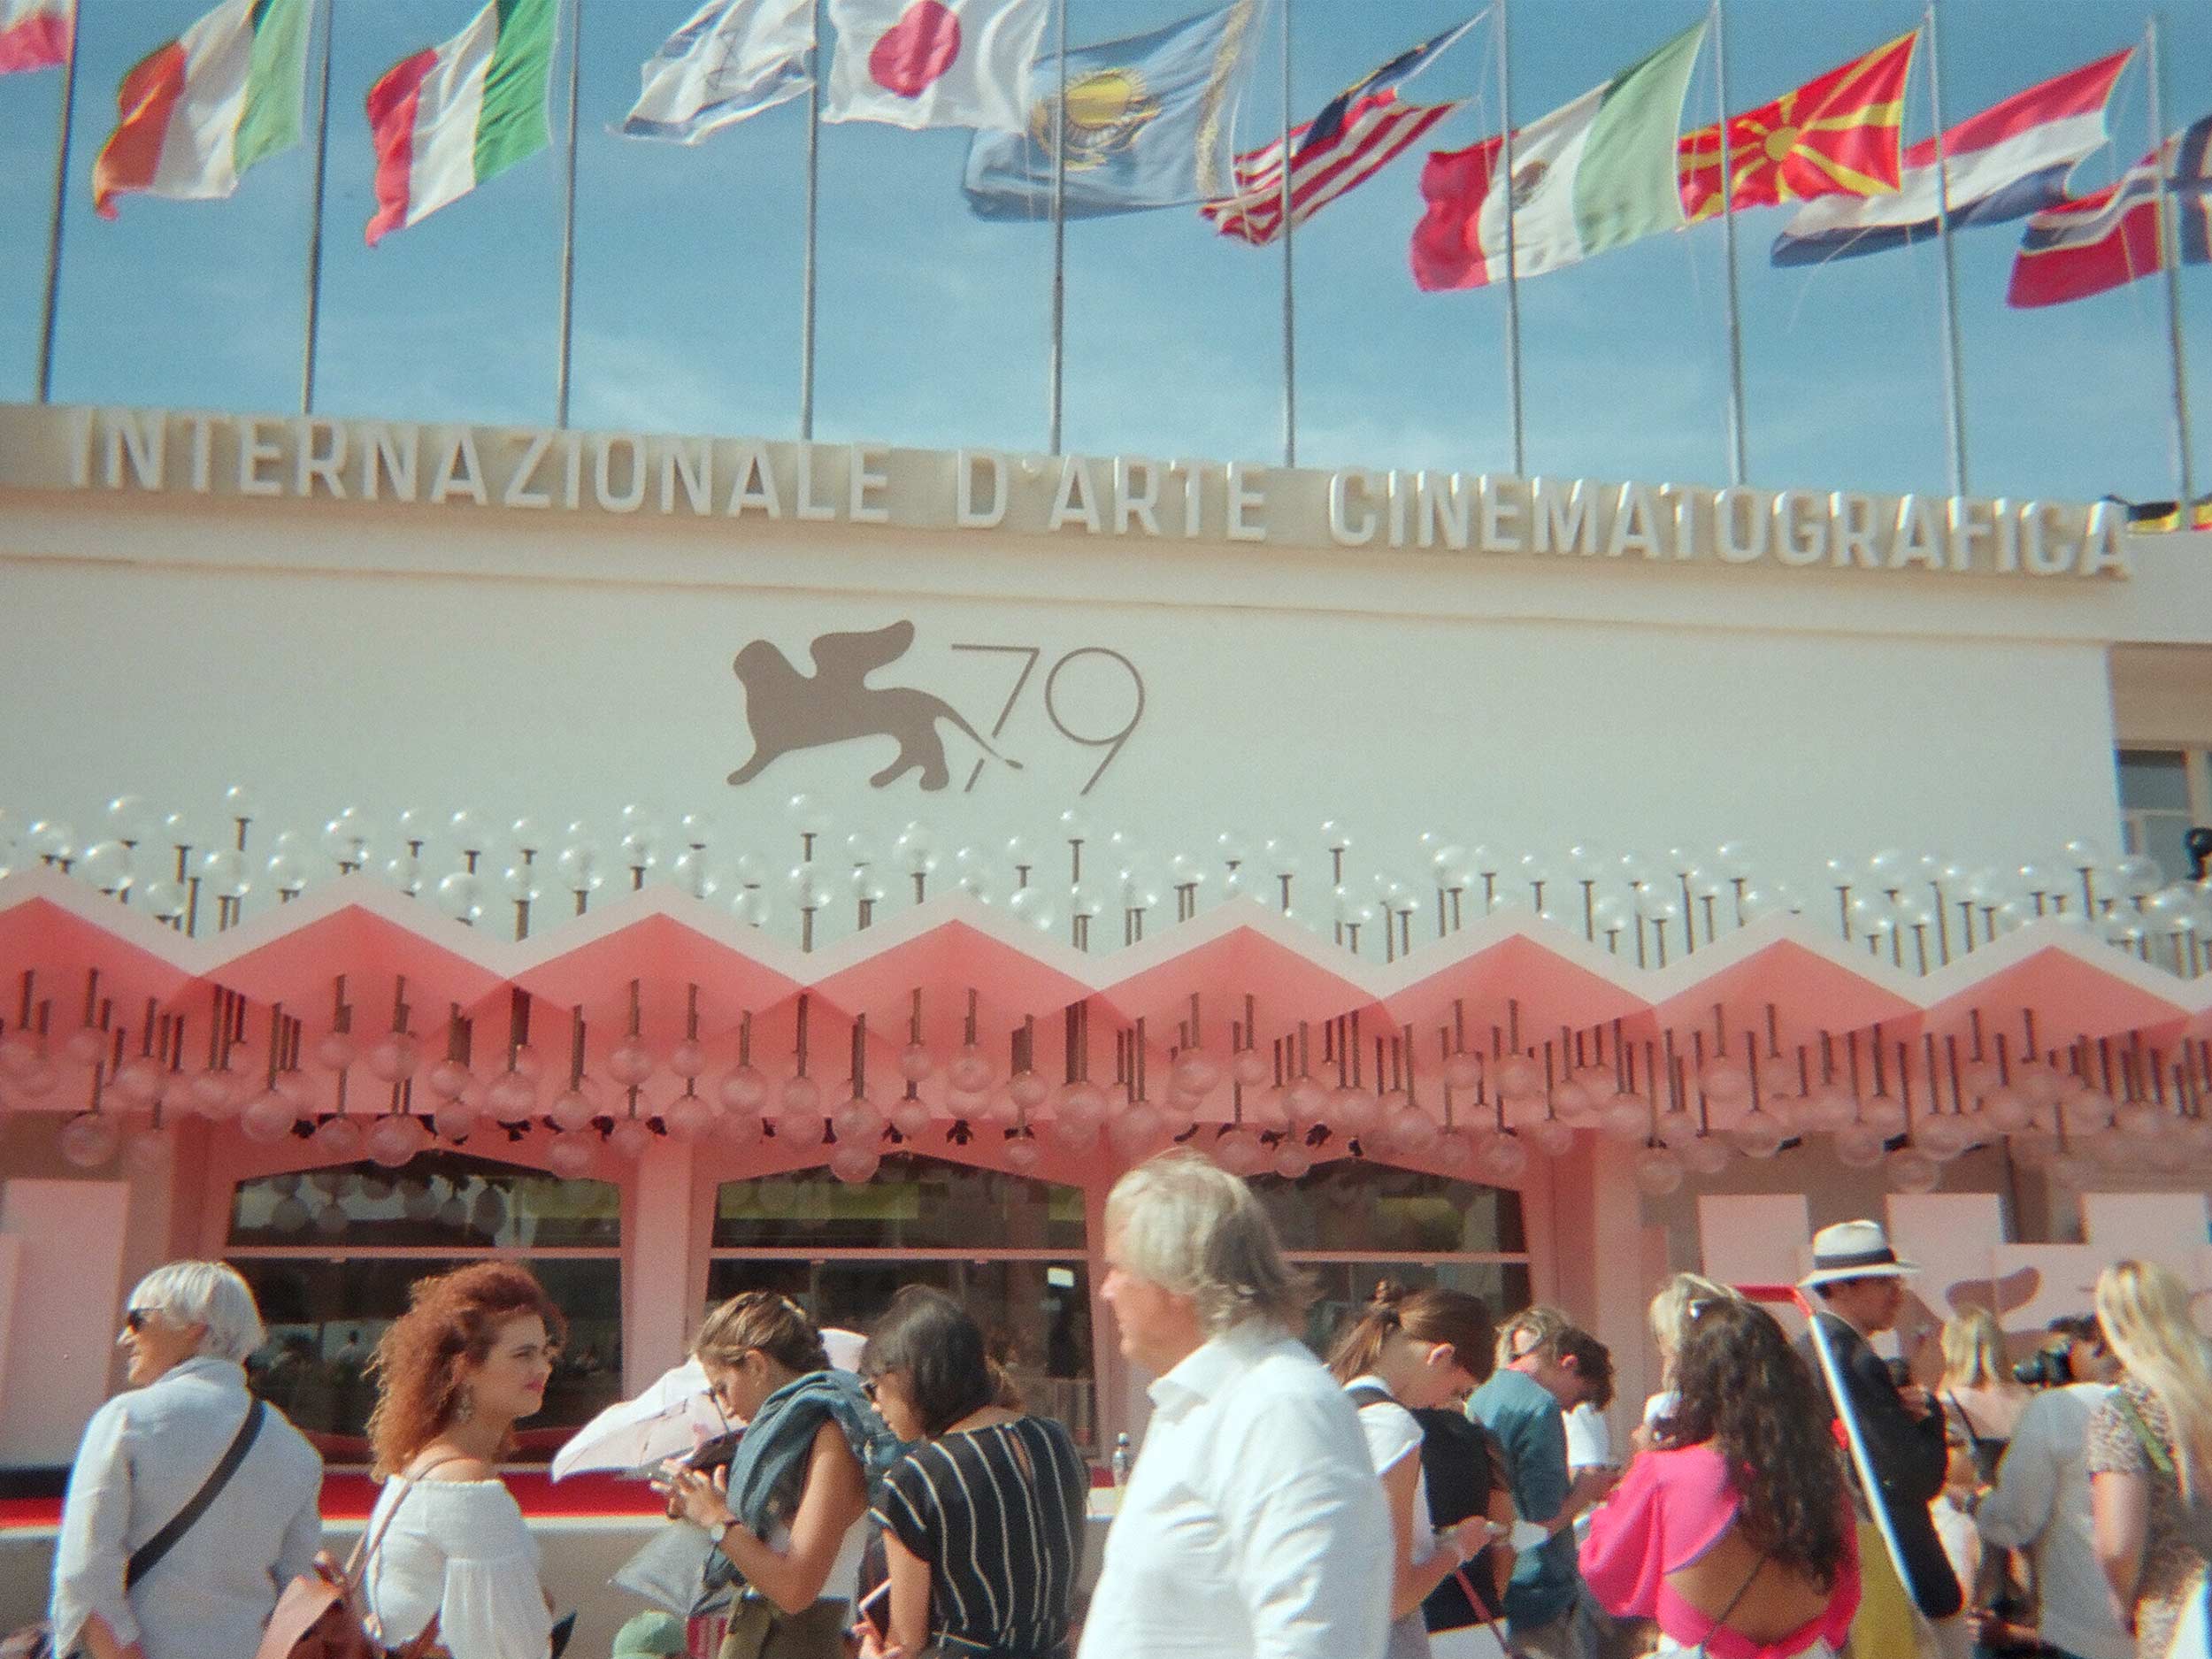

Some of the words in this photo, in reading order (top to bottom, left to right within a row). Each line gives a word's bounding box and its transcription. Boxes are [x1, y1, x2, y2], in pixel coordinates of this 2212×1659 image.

[69, 408, 890, 524] INTERNAZIONALE
[955, 449, 1268, 541] D'ARTE
[1327, 468, 2131, 578] CINEMATOGRAFICA
[950, 643, 1144, 795] 79
